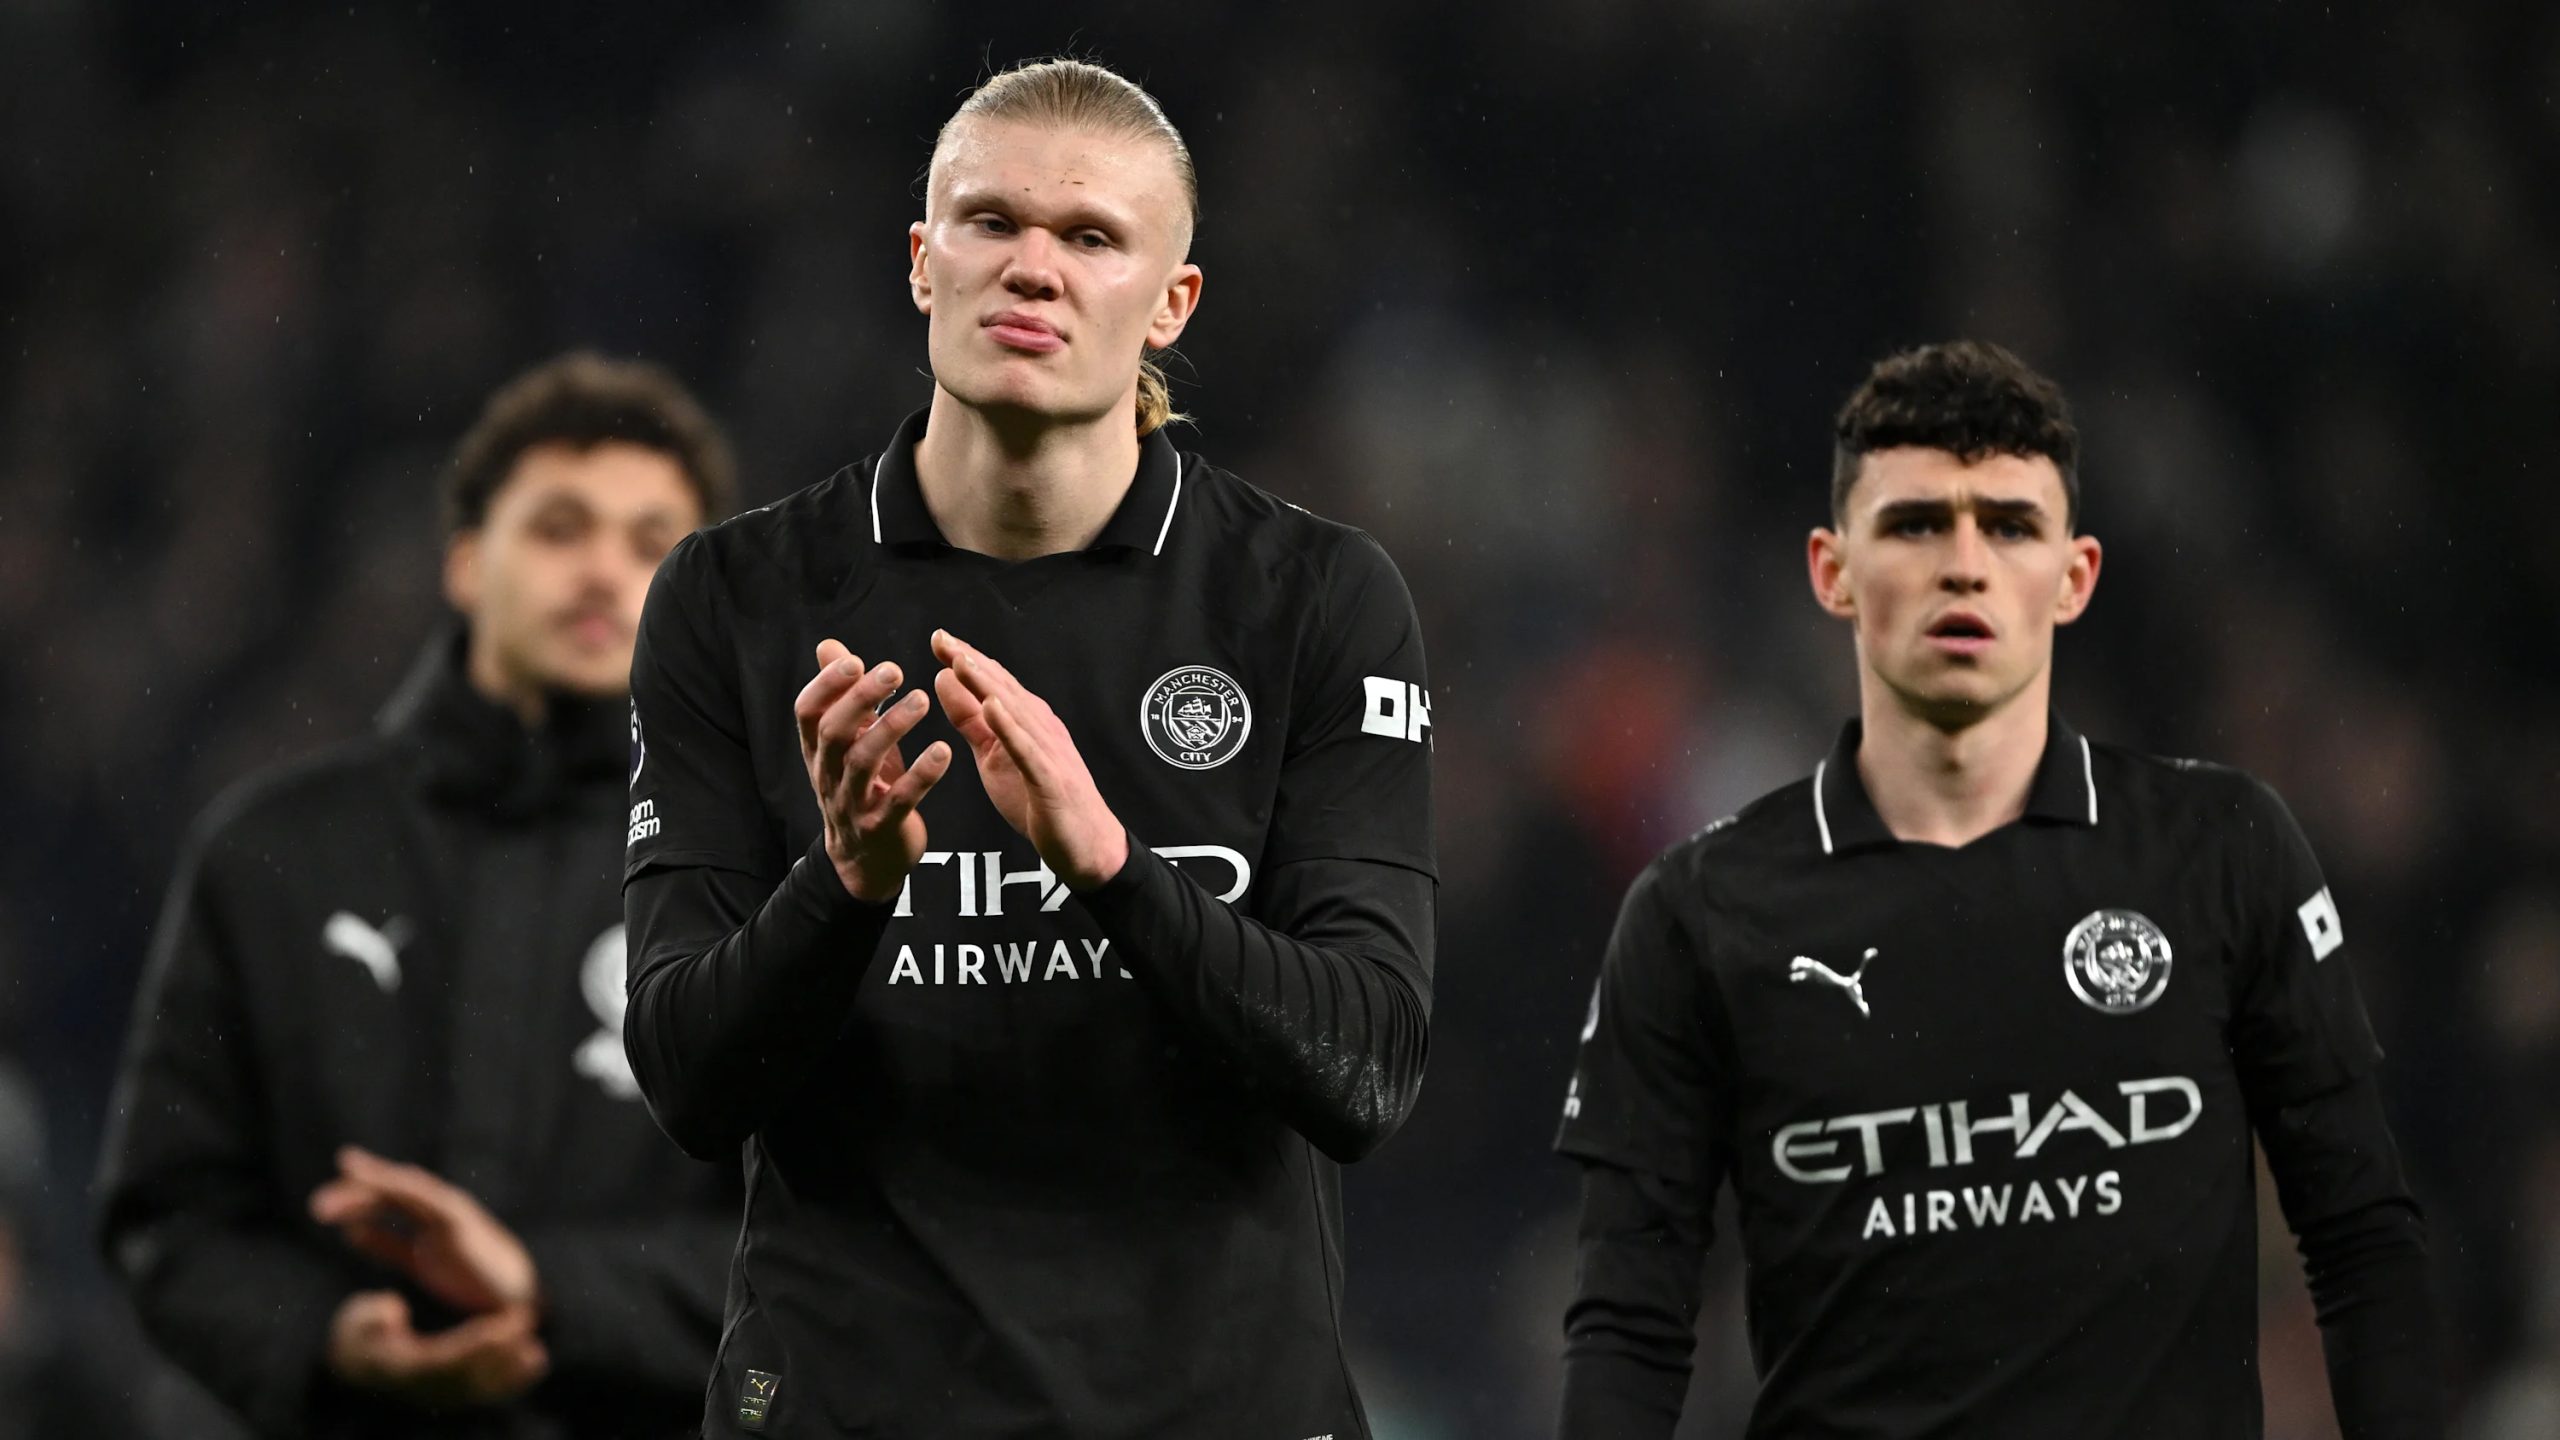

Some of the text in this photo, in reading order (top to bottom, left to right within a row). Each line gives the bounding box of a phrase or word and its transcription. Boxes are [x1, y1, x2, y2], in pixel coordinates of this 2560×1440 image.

[1154, 673, 1240, 707] MANCHESTER
[1179, 751, 1212, 763] CITY
[887, 938, 1134, 985] AIRWAY
[1772, 1075, 2204, 1183] ETIHAD
[1861, 1170, 2123, 1240] AIRWAYS
